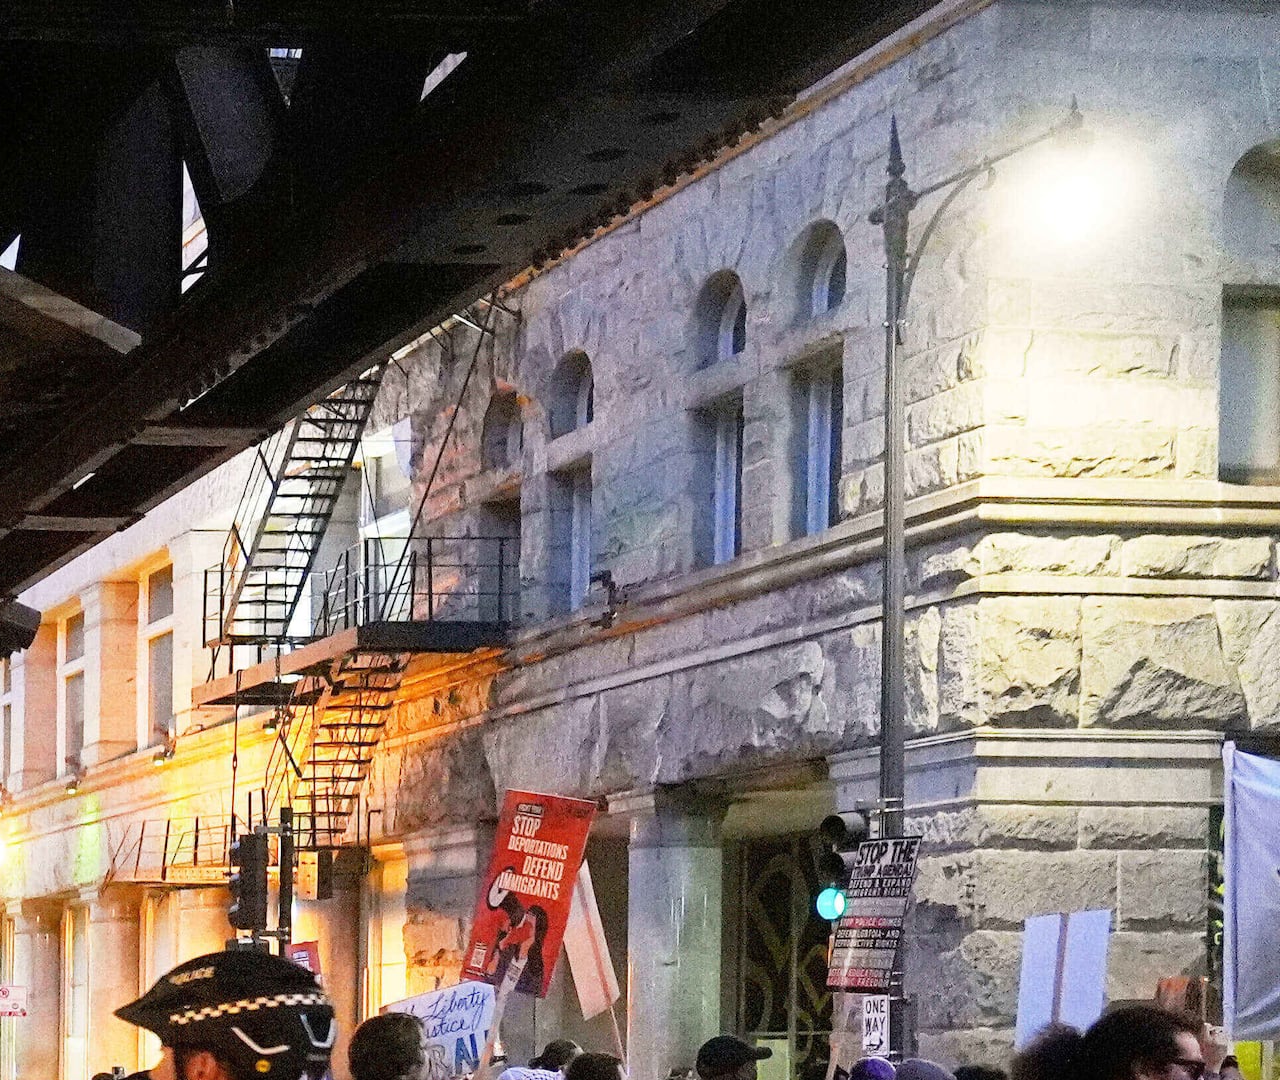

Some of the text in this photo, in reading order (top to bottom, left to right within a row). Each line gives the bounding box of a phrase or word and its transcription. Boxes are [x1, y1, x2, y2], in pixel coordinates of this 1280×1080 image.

[512, 815, 541, 838] STOP
[507, 834, 569, 861] DEPORTATIONS
[857, 840, 918, 865] STOP THE
[522, 856, 565, 882] DEFEND
[497, 871, 561, 901] IMMIGRANTS
[421, 986, 490, 1031] Liberty
[865, 1000, 886, 1015] ONE
[864, 1016, 887, 1031] WAY
